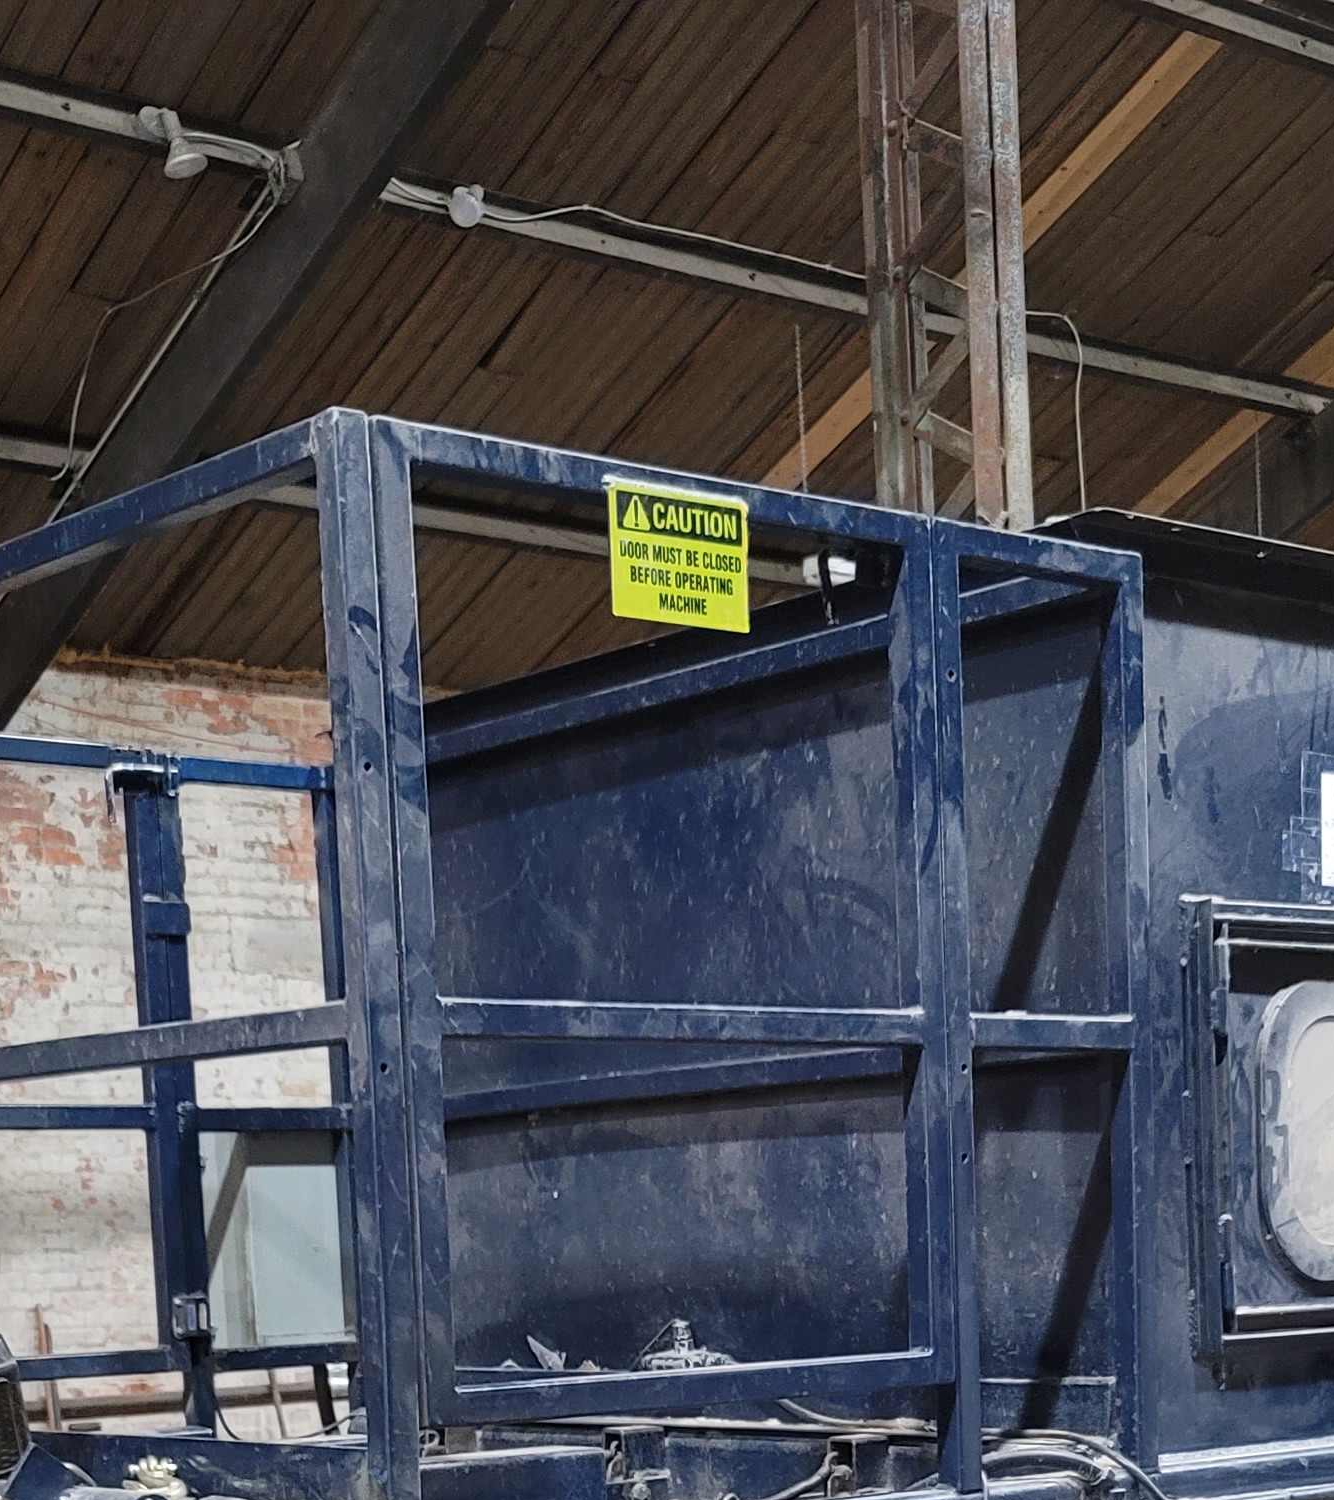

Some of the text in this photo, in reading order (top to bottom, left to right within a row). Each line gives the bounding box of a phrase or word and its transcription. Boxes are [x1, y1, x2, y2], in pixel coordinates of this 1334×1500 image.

[652, 502, 737, 540] CAUTION
[619, 540, 742, 574] DOOR MUST BE CLOSED
[630, 565, 733, 595] BEFORE OPERATING
[659, 593, 707, 615] MACHINE
